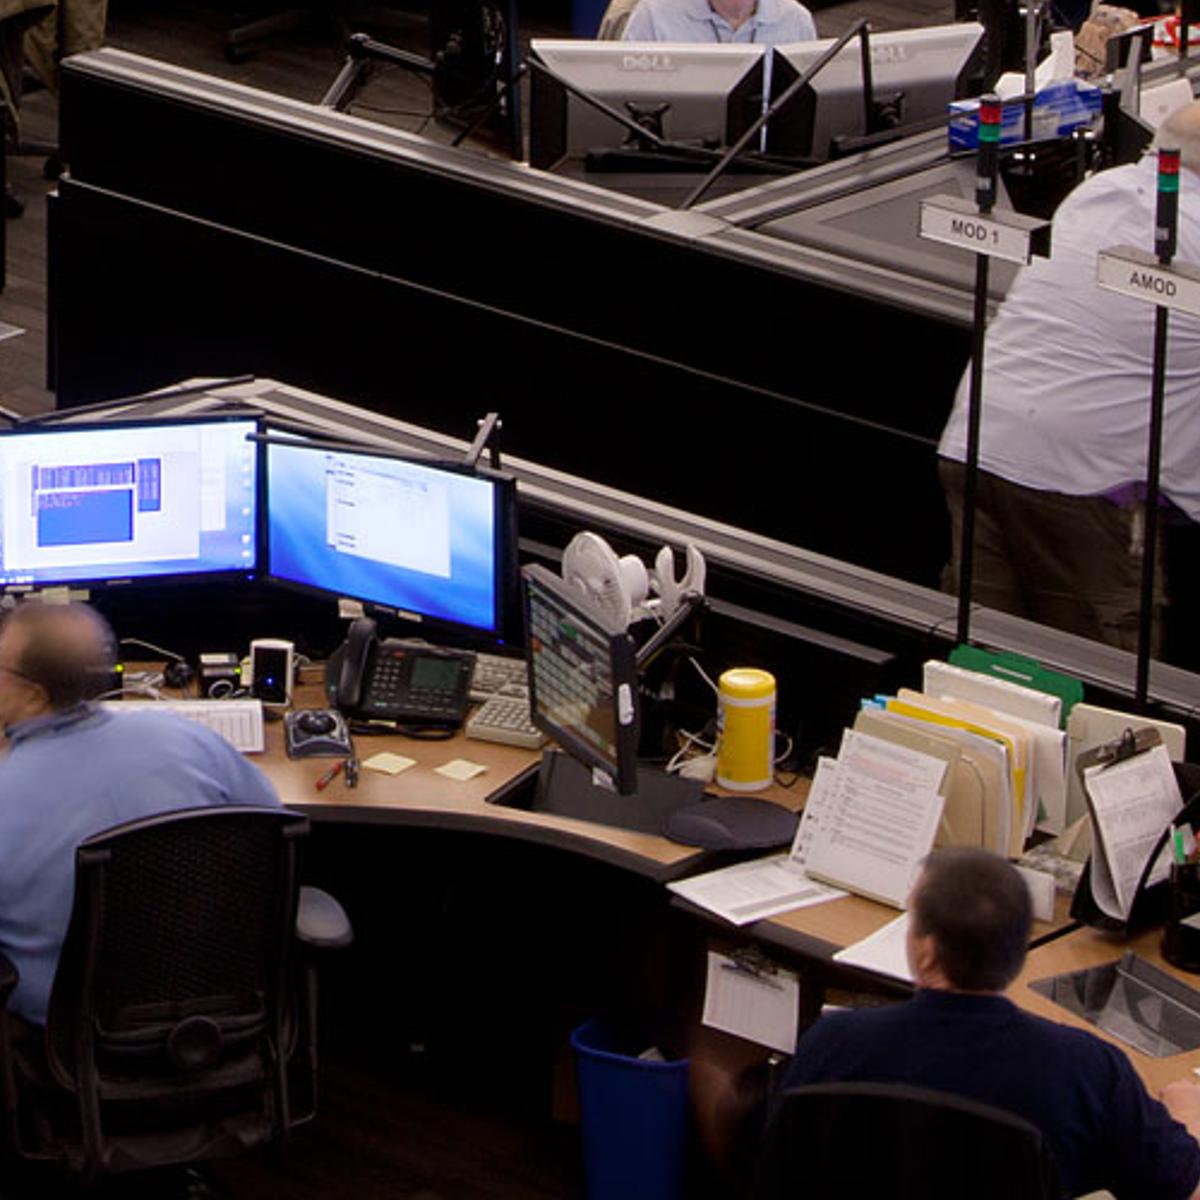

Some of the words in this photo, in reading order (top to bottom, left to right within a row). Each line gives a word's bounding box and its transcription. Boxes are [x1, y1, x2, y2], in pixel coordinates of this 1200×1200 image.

[951, 219, 987, 241] MOD
[992, 230, 999, 244] 1
[1129, 271, 1177, 297] AMOD
